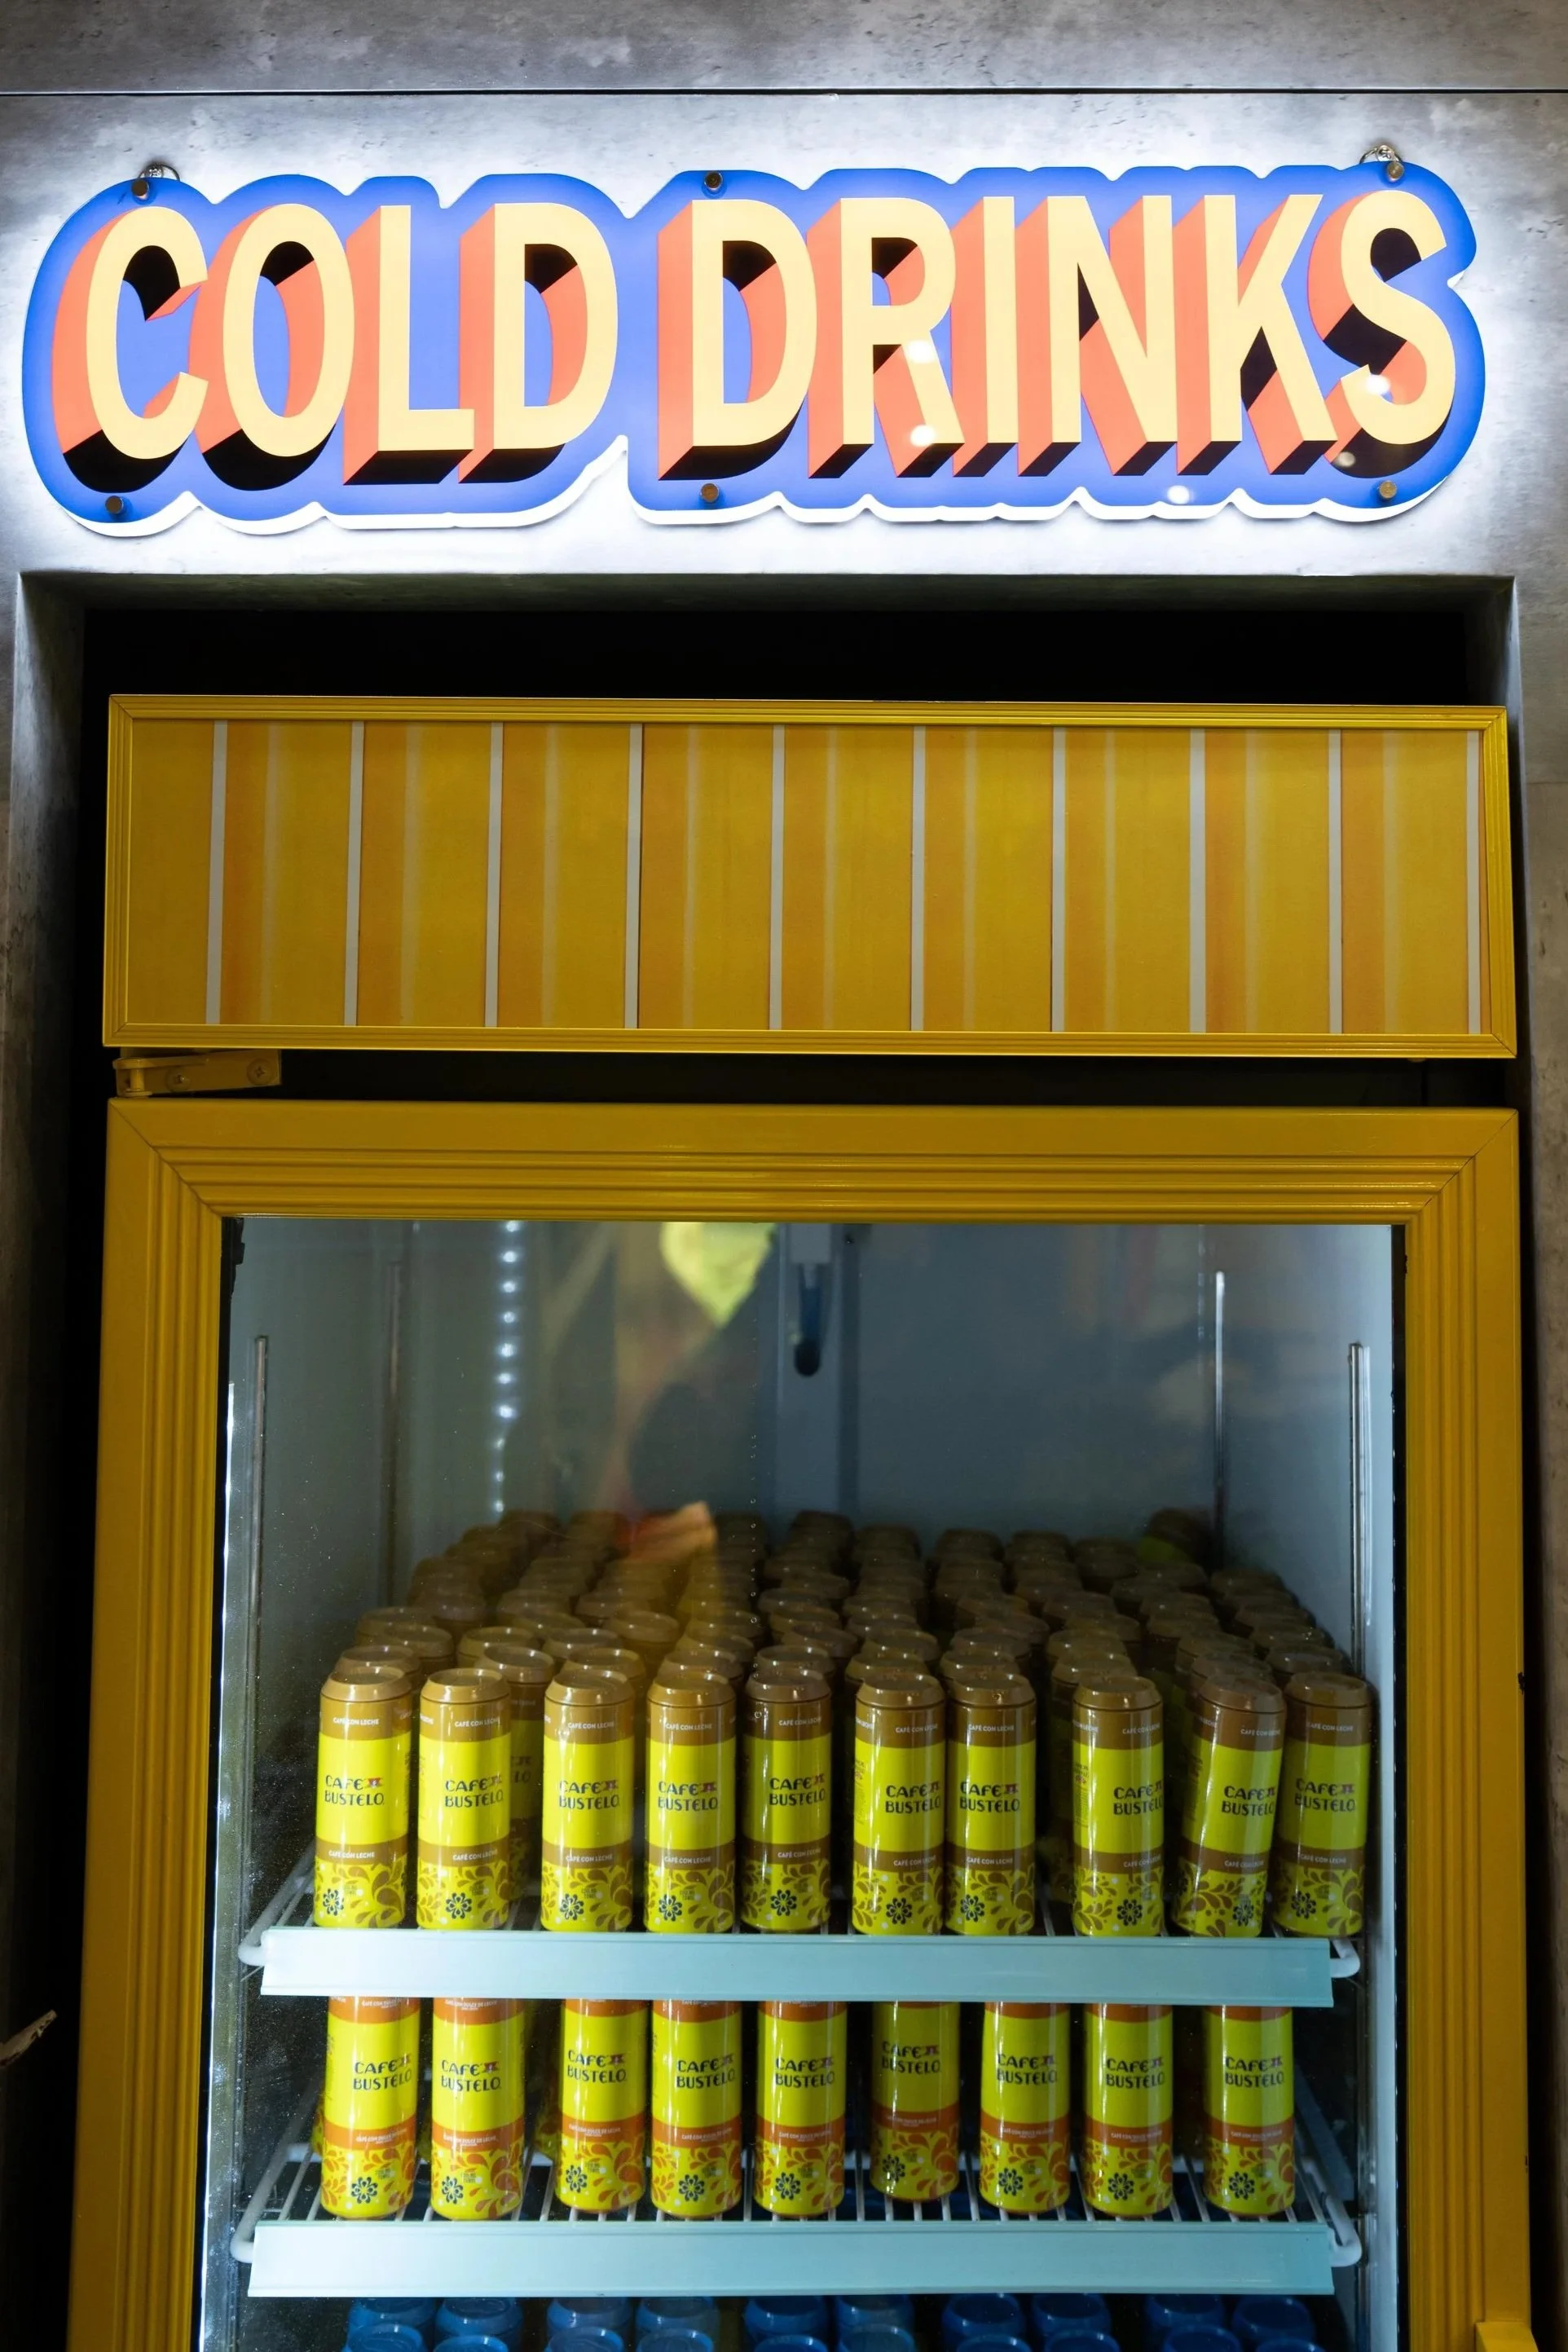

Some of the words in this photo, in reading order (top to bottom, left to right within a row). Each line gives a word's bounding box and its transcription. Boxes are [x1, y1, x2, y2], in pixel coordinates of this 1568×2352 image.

[53, 202, 619, 492] COLD
[658, 189, 1458, 479] DRINKS
[324, 1790, 384, 1806] BUSTELO
[445, 1790, 504, 1808] BUSTELO
[559, 1795, 619, 1809] BUSTELO
[658, 1796, 718, 1811] BUSTELO
[769, 1789, 826, 1806] BUSTELO
[885, 1796, 940, 1813] BUSTELO
[960, 1798, 1020, 1812] BUSTELO
[1113, 1797, 1162, 1815] BUSTELO
[1294, 1793, 1356, 1812] BUSTELO
[1222, 1801, 1275, 1816] BUSTELO
[567, 2065, 626, 2083] BUSTELO
[881, 2056, 940, 2075] BUSTELO
[354, 2070, 412, 2090] BUSTELO
[442, 2075, 500, 2093] BUSTELO
[676, 2069, 735, 2089] BUSTELO
[775, 2072, 835, 2088] BUSTELO
[997, 2069, 1057, 2086] BUSTELO
[1106, 2072, 1165, 2089] BUSTELO
[1225, 2072, 1284, 2088] BUSTELO
